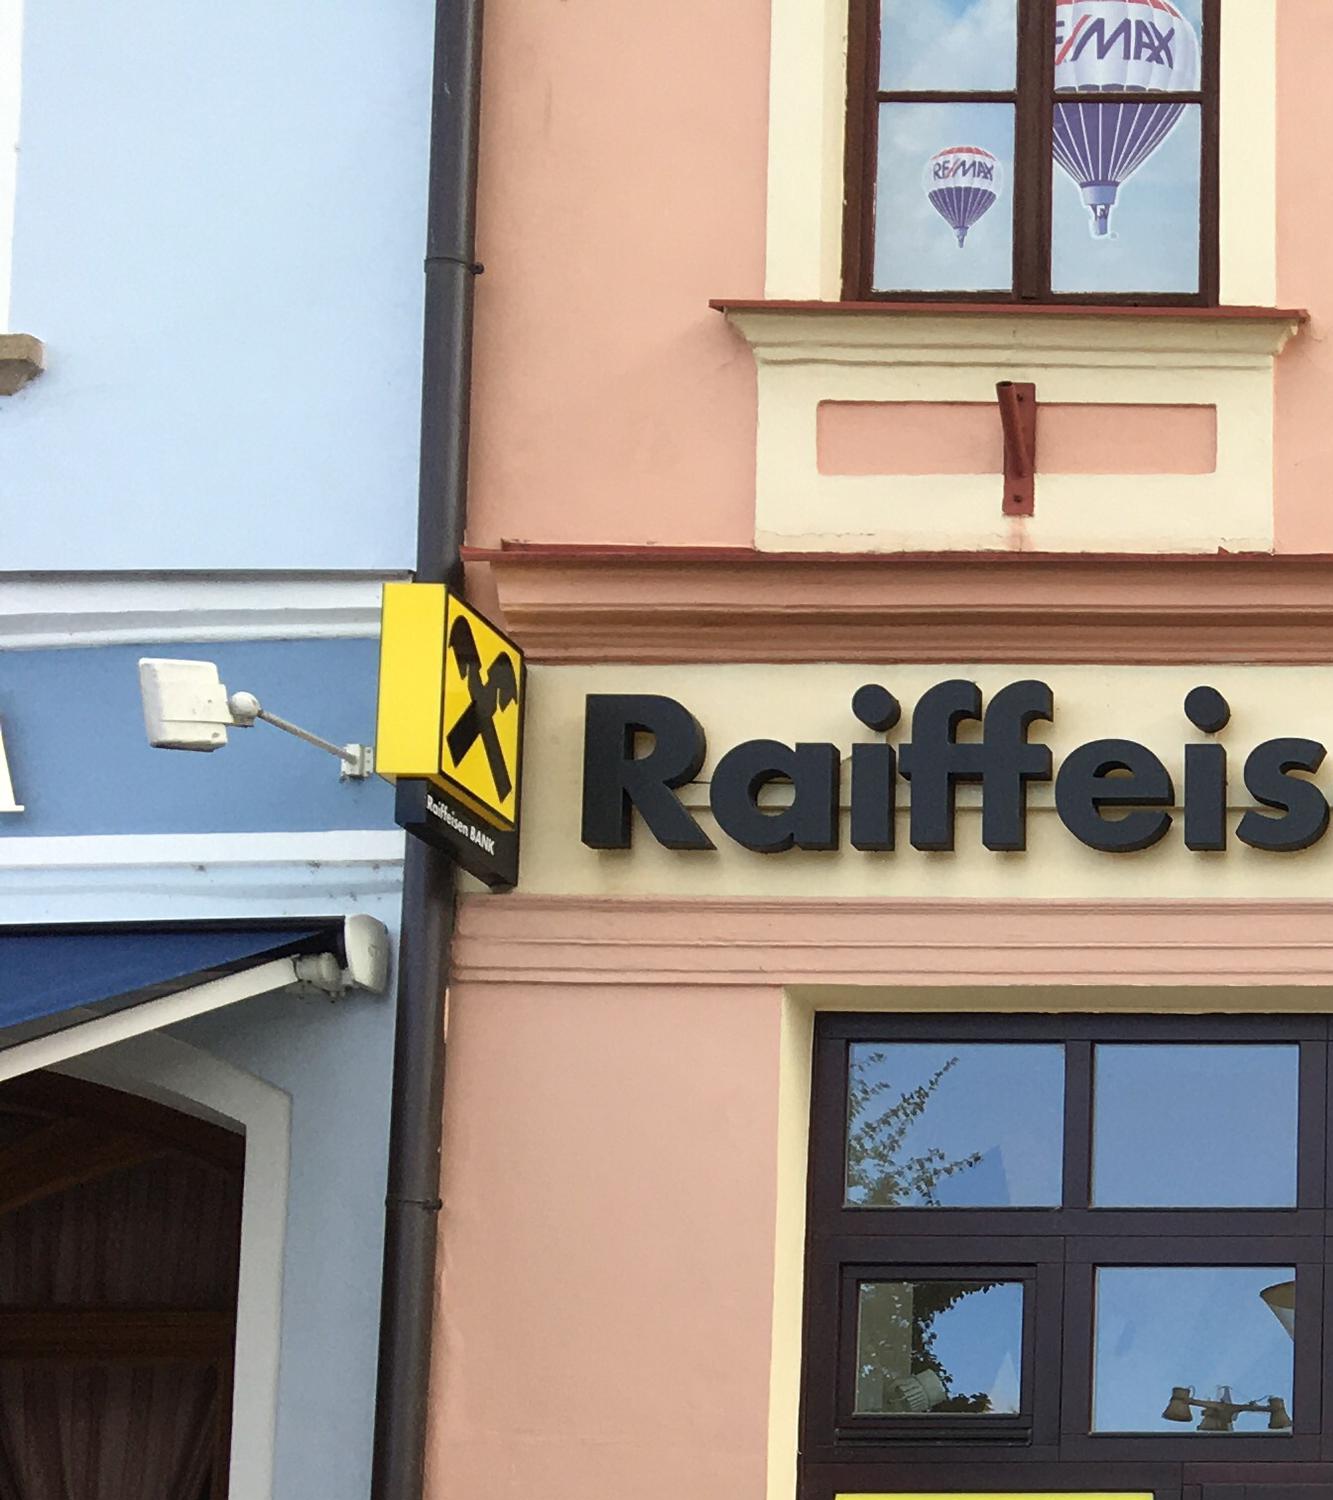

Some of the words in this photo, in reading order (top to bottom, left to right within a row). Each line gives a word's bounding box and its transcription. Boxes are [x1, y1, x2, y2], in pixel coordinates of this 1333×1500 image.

[1055, 14, 1175, 69] /MAX
[933, 158, 994, 181] RE/MAX
[426, 794, 469, 837] Raiffeisen
[470, 826, 495, 856] BANK
